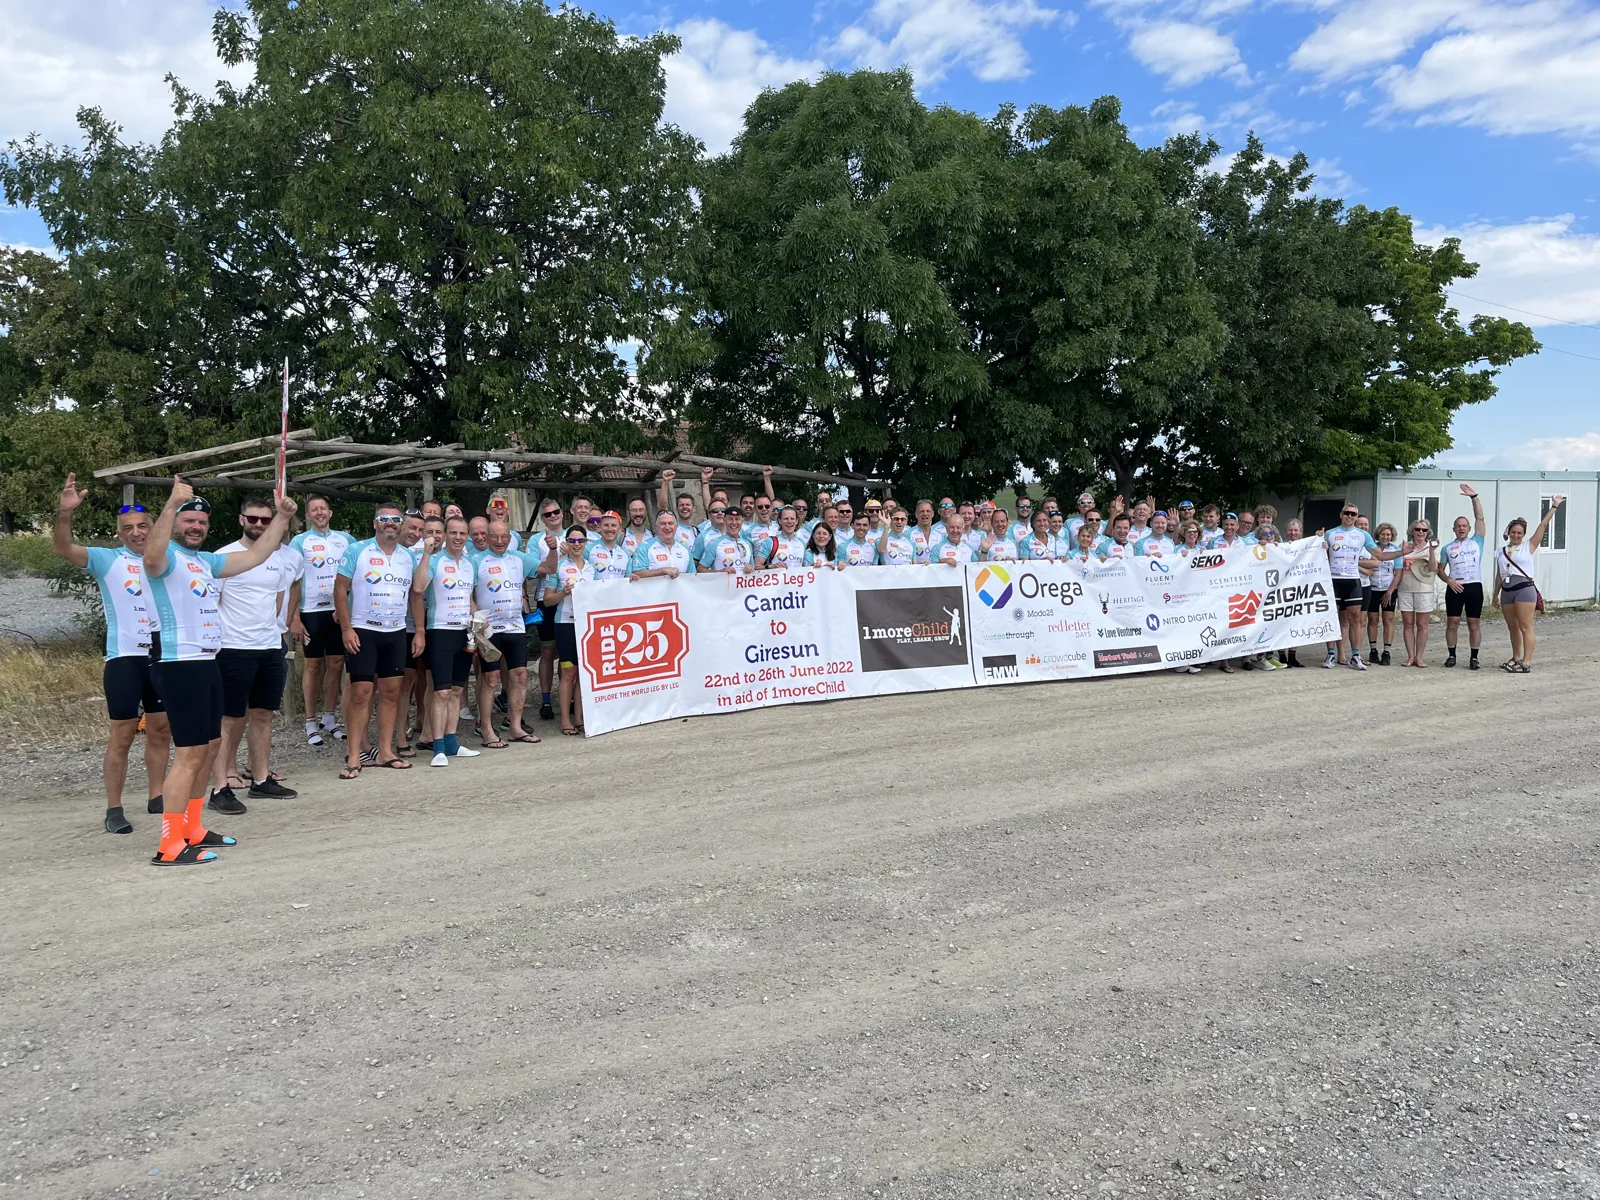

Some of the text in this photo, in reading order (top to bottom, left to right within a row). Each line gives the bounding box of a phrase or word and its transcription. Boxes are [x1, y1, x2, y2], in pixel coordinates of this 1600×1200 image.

[1191, 554, 1223, 568] SEKO
[608, 565, 626, 578] Oreg
[384, 574, 411, 586] Orega
[736, 572, 815, 588] Ride25 Leg 9
[1210, 575, 1253, 585] SCENTERED
[1019, 573, 1083, 605] Orega
[1264, 582, 1327, 606] SIGMA
[744, 592, 808, 617] Çandir
[1113, 596, 1144, 604] HERITAGE
[1027, 609, 1054, 618] Modo25
[1163, 612, 1218, 625] NITRO DIGITAL
[1263, 600, 1329, 622] SPORTS
[770, 620, 787, 635] to
[863, 622, 949, 640] 1moreChild
[1048, 620, 1091, 632] red letter
[1105, 627, 1142, 638] Love Ventures
[1290, 621, 1334, 638] buyagift
[617, 617, 668, 666] 25
[1210, 635, 1246, 647] FRAMEWORKS
[601, 624, 616, 676] RIDE
[745, 643, 819, 663] Giresun
[1166, 649, 1203, 662] GRUBBY
[1044, 652, 1086, 664] crowdcube
[705, 661, 853, 688] 22nd to 26th June 2022
[984, 665, 1019, 679] EMW
[595, 693, 618, 703] EXPLORE
[631, 688, 649, 696] WORLD
[717, 681, 845, 706] in aid of 1moreChild
